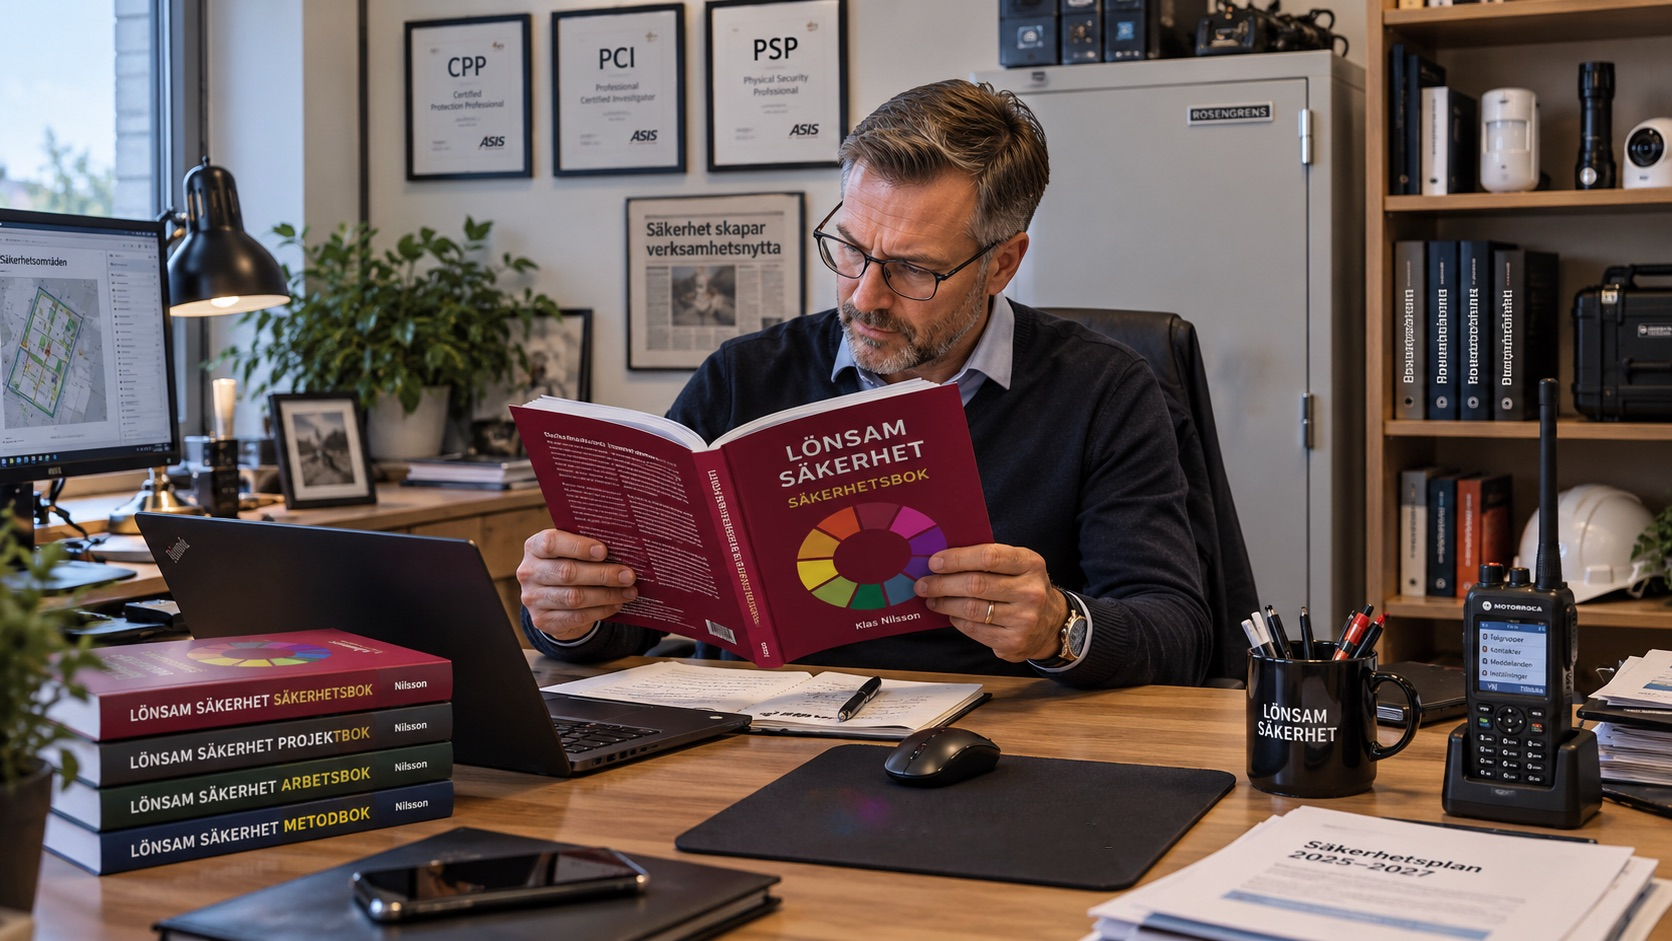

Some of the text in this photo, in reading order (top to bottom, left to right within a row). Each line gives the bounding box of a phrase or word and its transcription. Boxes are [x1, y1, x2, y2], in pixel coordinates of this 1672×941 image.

[599, 47, 635, 70] PCI
[754, 37, 798, 61] PSP
[448, 56, 487, 78] CPP
[743, 73, 809, 86] Physical Security
[430, 100, 505, 111] Protection Professional
[1192, 107, 1267, 119] ROSENGRENS
[630, 130, 658, 142] ASIS
[789, 124, 819, 136] ASIS
[479, 136, 505, 148] ASIS
[646, 220, 766, 239] Säkerhet skapar
[646, 240, 782, 259] verksamhetsnytta
[785, 419, 907, 462] LÖNSAM
[779, 440, 925, 488] SÄKERHET
[787, 468, 930, 509] SÄKERHETSBOK
[855, 611, 921, 630] Klas Nilsson
[130, 680, 428, 722] LÖNSAM SÄKERHET SÄKERHETSBOK Nilsson
[1263, 702, 1327, 724] LÖNSAM
[1258, 720, 1338, 742] SÄKERHET
[130, 721, 428, 769] LÖNSAM SÄKERHET PROJEKTBOK Nilsson
[130, 760, 428, 814] LÖNSAM SÄKERHET ARBETSBOK Nilsson
[131, 799, 429, 858] LÖNSAM SÄKERHET METODBOK Nilsson
[1303, 840, 1483, 874] Säkerhetsplan
